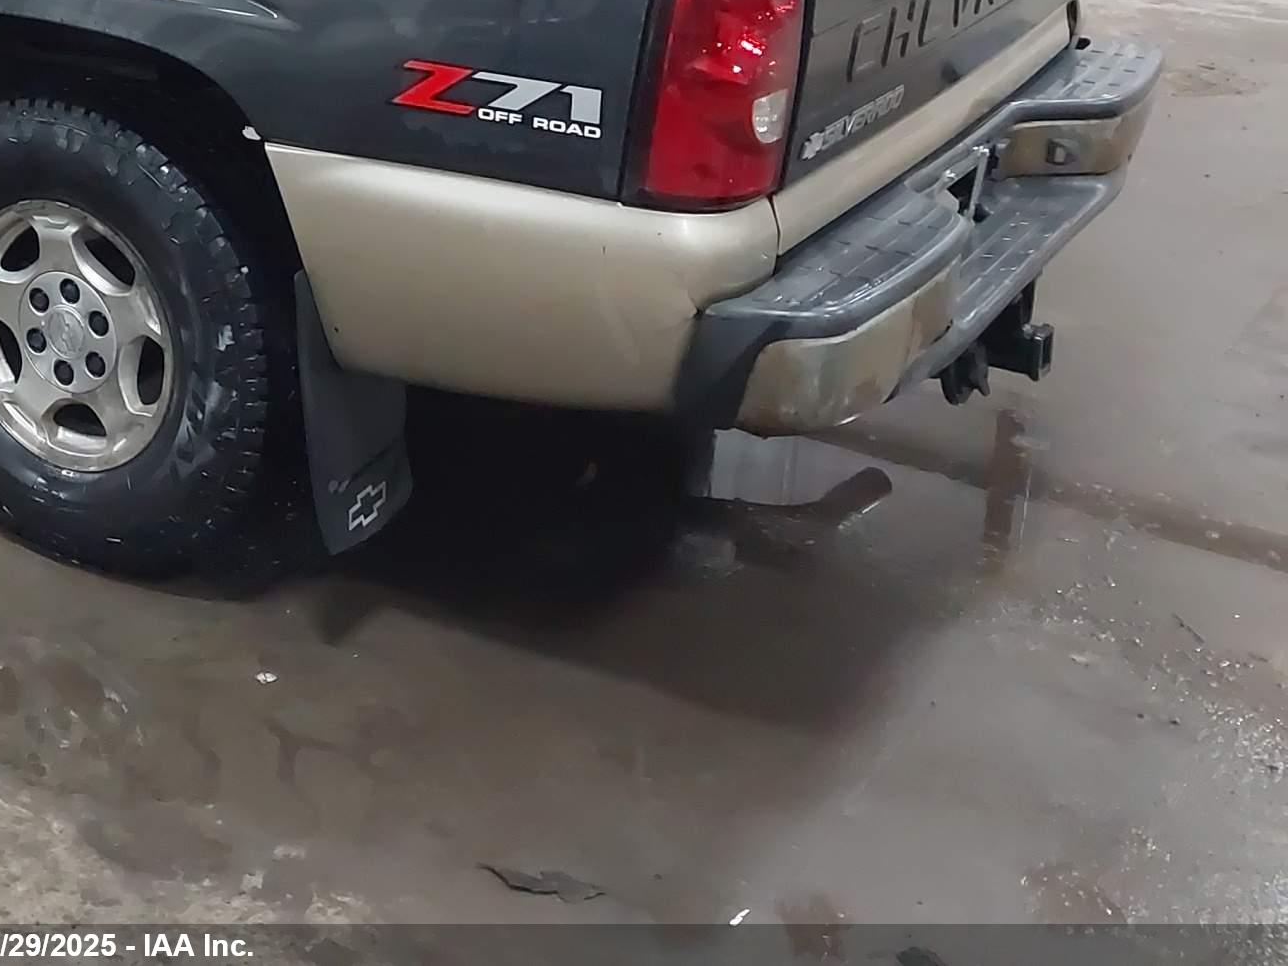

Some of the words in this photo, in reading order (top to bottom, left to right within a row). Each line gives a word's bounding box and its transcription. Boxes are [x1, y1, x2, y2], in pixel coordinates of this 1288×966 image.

[391, 59, 603, 125] Z71
[477, 107, 523, 125] OFF
[532, 116, 602, 139] ROAD
